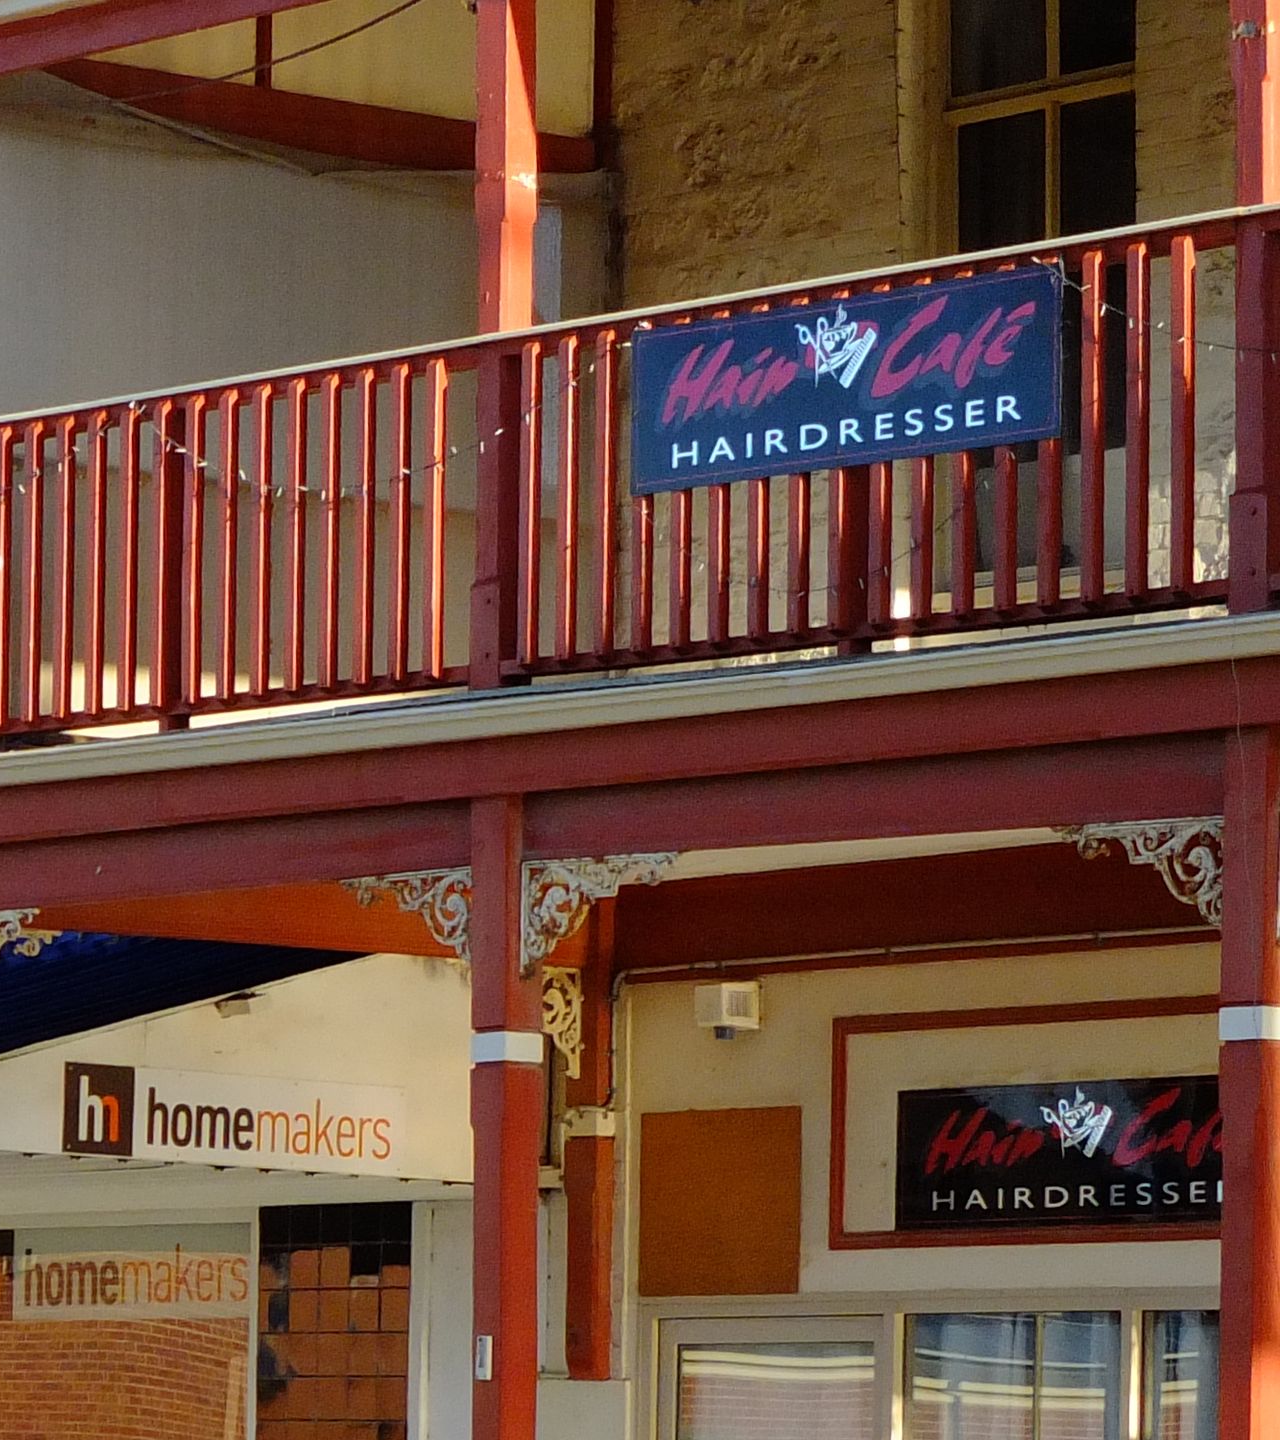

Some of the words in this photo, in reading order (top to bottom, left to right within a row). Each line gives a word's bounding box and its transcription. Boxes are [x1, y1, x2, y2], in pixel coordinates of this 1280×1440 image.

[661, 338, 800, 426] Hair
[871, 296, 1036, 398] Café
[670, 395, 1022, 469] HAIRDRESSER
[146, 1086, 392, 1161] homemakers
[923, 1107, 1044, 1176] Hair
[1112, 1087, 1222, 1168] Caf
[24, 1243, 249, 1307] homemakers
